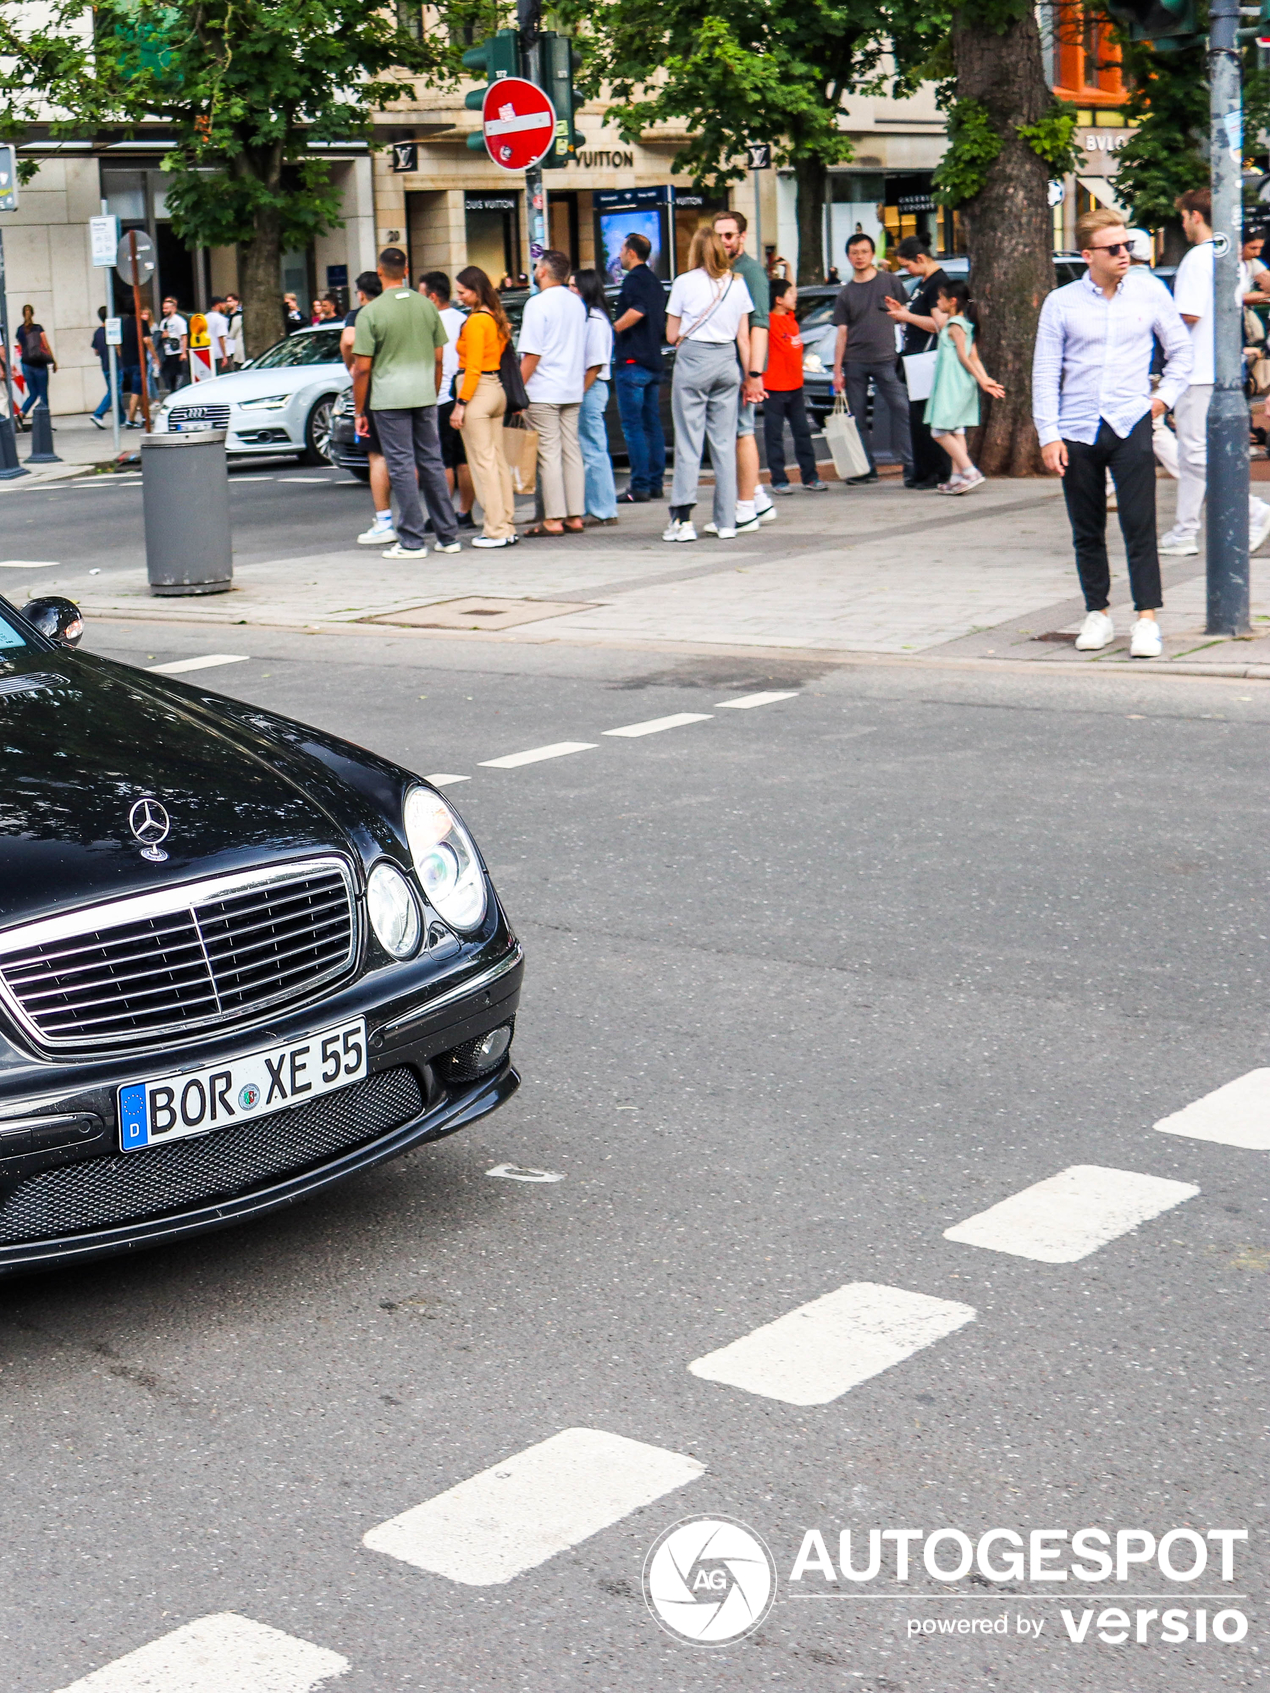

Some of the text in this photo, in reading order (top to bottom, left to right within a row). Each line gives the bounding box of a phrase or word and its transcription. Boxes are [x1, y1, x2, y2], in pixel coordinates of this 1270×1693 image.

[575, 151, 633, 168] VUITTON
[129, 1122, 141, 1138] D
[149, 1070, 236, 1136] BOR
[264, 1045, 313, 1105] XE
[321, 1026, 363, 1084] 55
